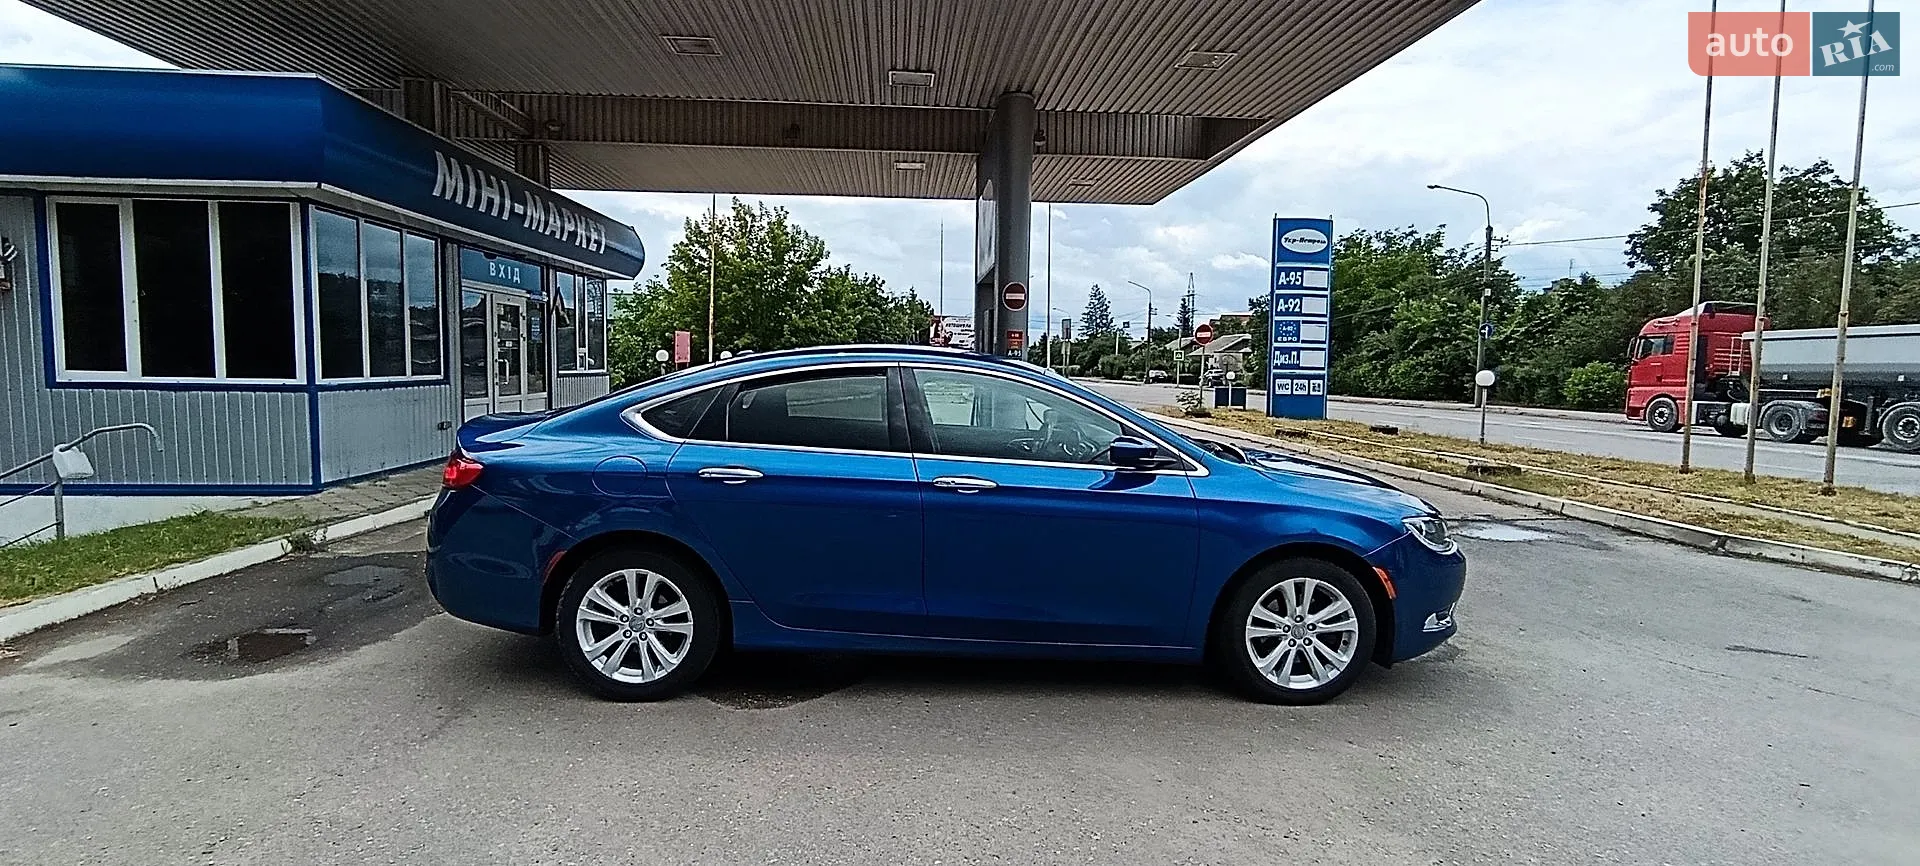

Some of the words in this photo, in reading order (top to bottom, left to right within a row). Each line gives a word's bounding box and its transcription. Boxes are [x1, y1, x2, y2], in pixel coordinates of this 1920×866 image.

[432, 150, 608, 254] МІНІ-МАРКЕТ
[489, 262, 521, 284] ВХІД
[1278, 271, 1302, 286] А-95
[1277, 298, 1301, 313] А-92
[1276, 383, 1290, 391] WC
[1294, 382, 1307, 392] 24h
